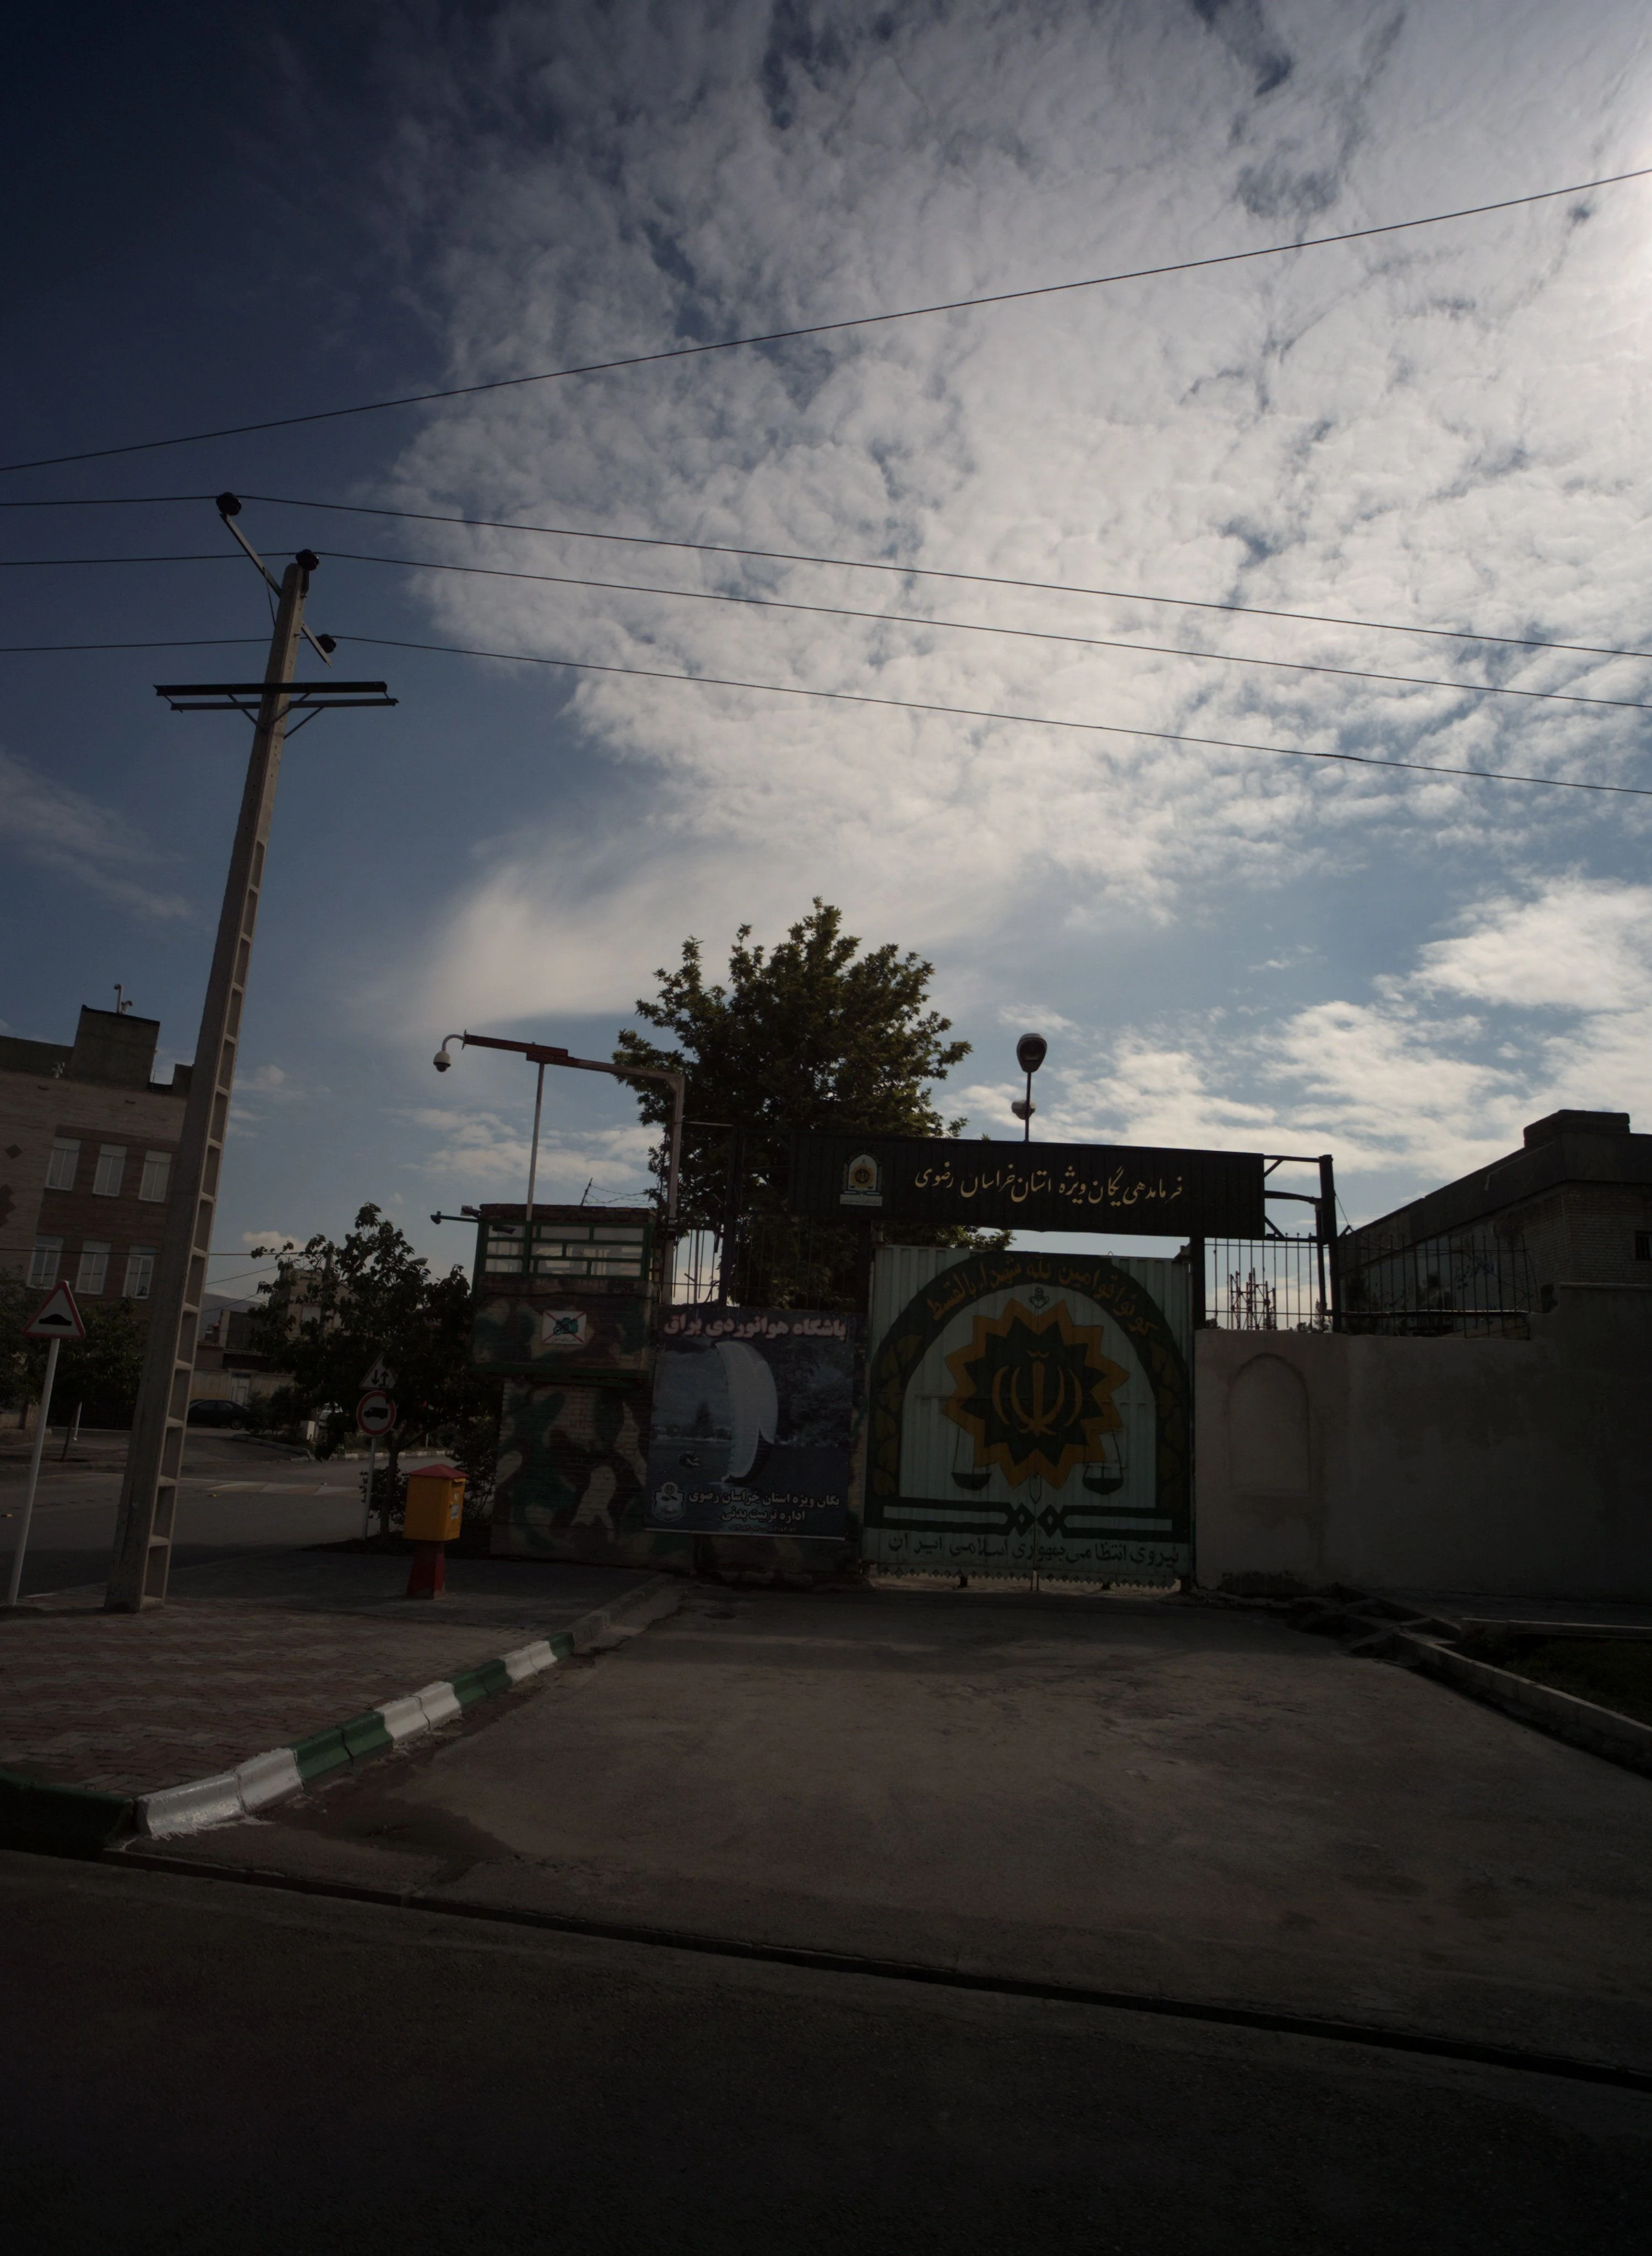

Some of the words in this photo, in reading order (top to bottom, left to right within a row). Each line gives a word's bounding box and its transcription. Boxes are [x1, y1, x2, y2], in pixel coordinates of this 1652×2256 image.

[914, 1161, 955, 1188] رضوی
[959, 1163, 1017, 1198] خراسان
[1010, 1170, 1053, 1203] استان
[1058, 1165, 1087, 1205] ویژه
[1088, 1165, 1124, 1207] یگان
[704, 1315, 790, 1339] هوانوردی
[792, 1317, 847, 1342] باشگاه
[688, 1489, 719, 1504] رضوی
[721, 1489, 760, 1505] خراسان
[762, 1492, 790, 1506] استان
[792, 1493, 814, 1508] ویژه
[816, 1493, 840, 1509] یگان
[721, 1505, 747, 1521] بدنی
[749, 1508, 778, 1523] تربیت
[779, 1510, 806, 1523] اداره
[888, 1532, 942, 1554] ایران
[949, 1537, 1008, 1557] اسلامی
[1012, 1543, 1066, 1562] جمهوری
[1066, 1542, 1127, 1564] انتظامی
[1130, 1547, 1179, 1568] نیروی
